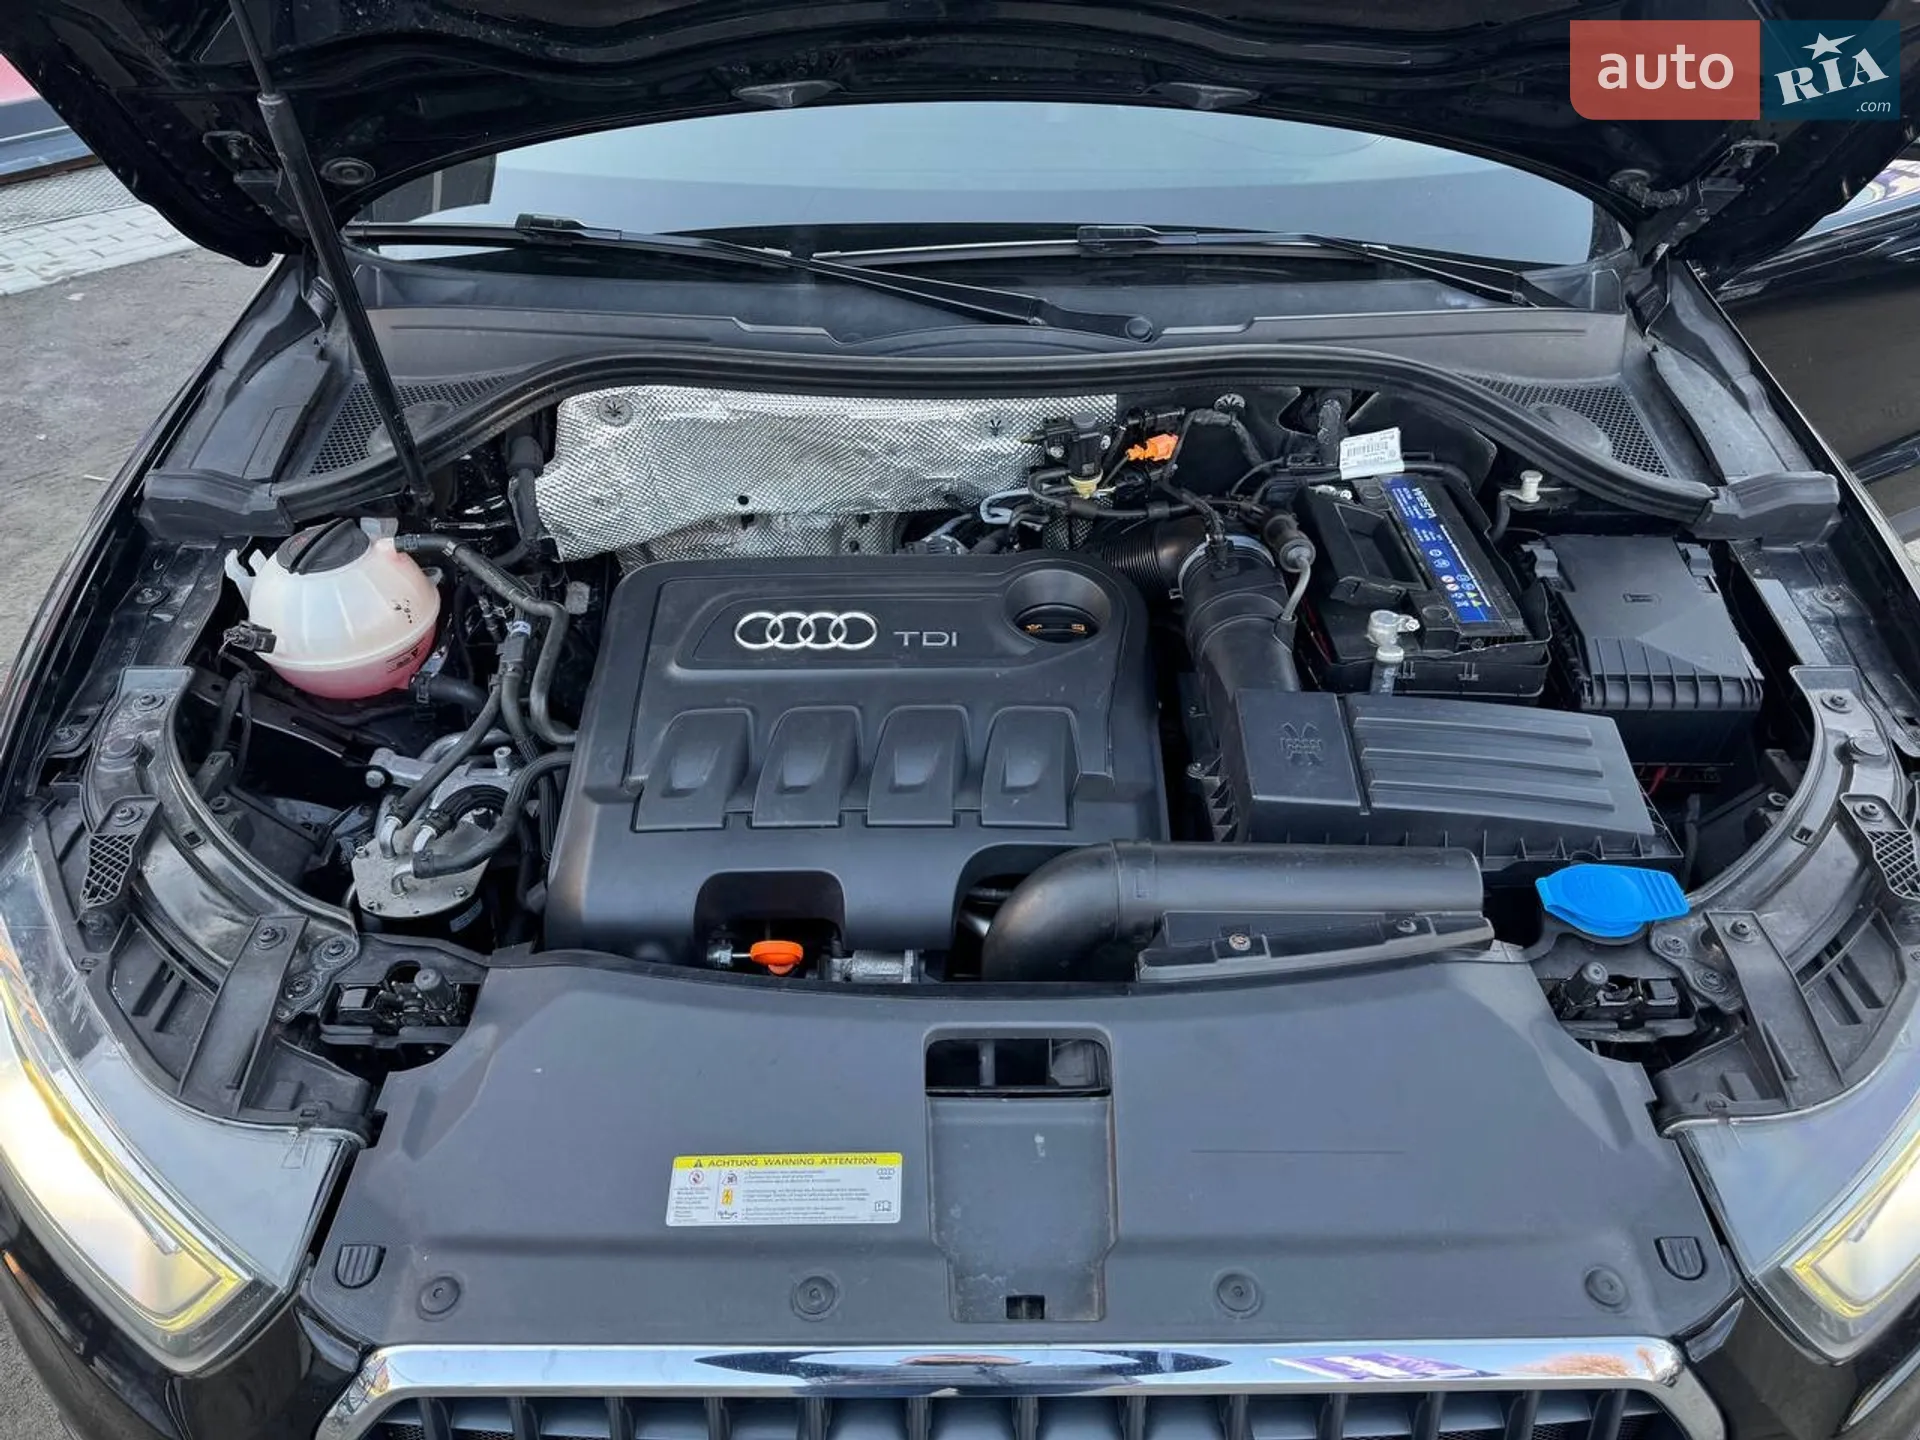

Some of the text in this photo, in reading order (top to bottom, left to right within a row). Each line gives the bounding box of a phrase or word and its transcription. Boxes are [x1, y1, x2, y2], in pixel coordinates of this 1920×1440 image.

[893, 631, 957, 647] TDI
[708, 1156, 878, 1168] ACHTUNG WARNING ATTENTION
